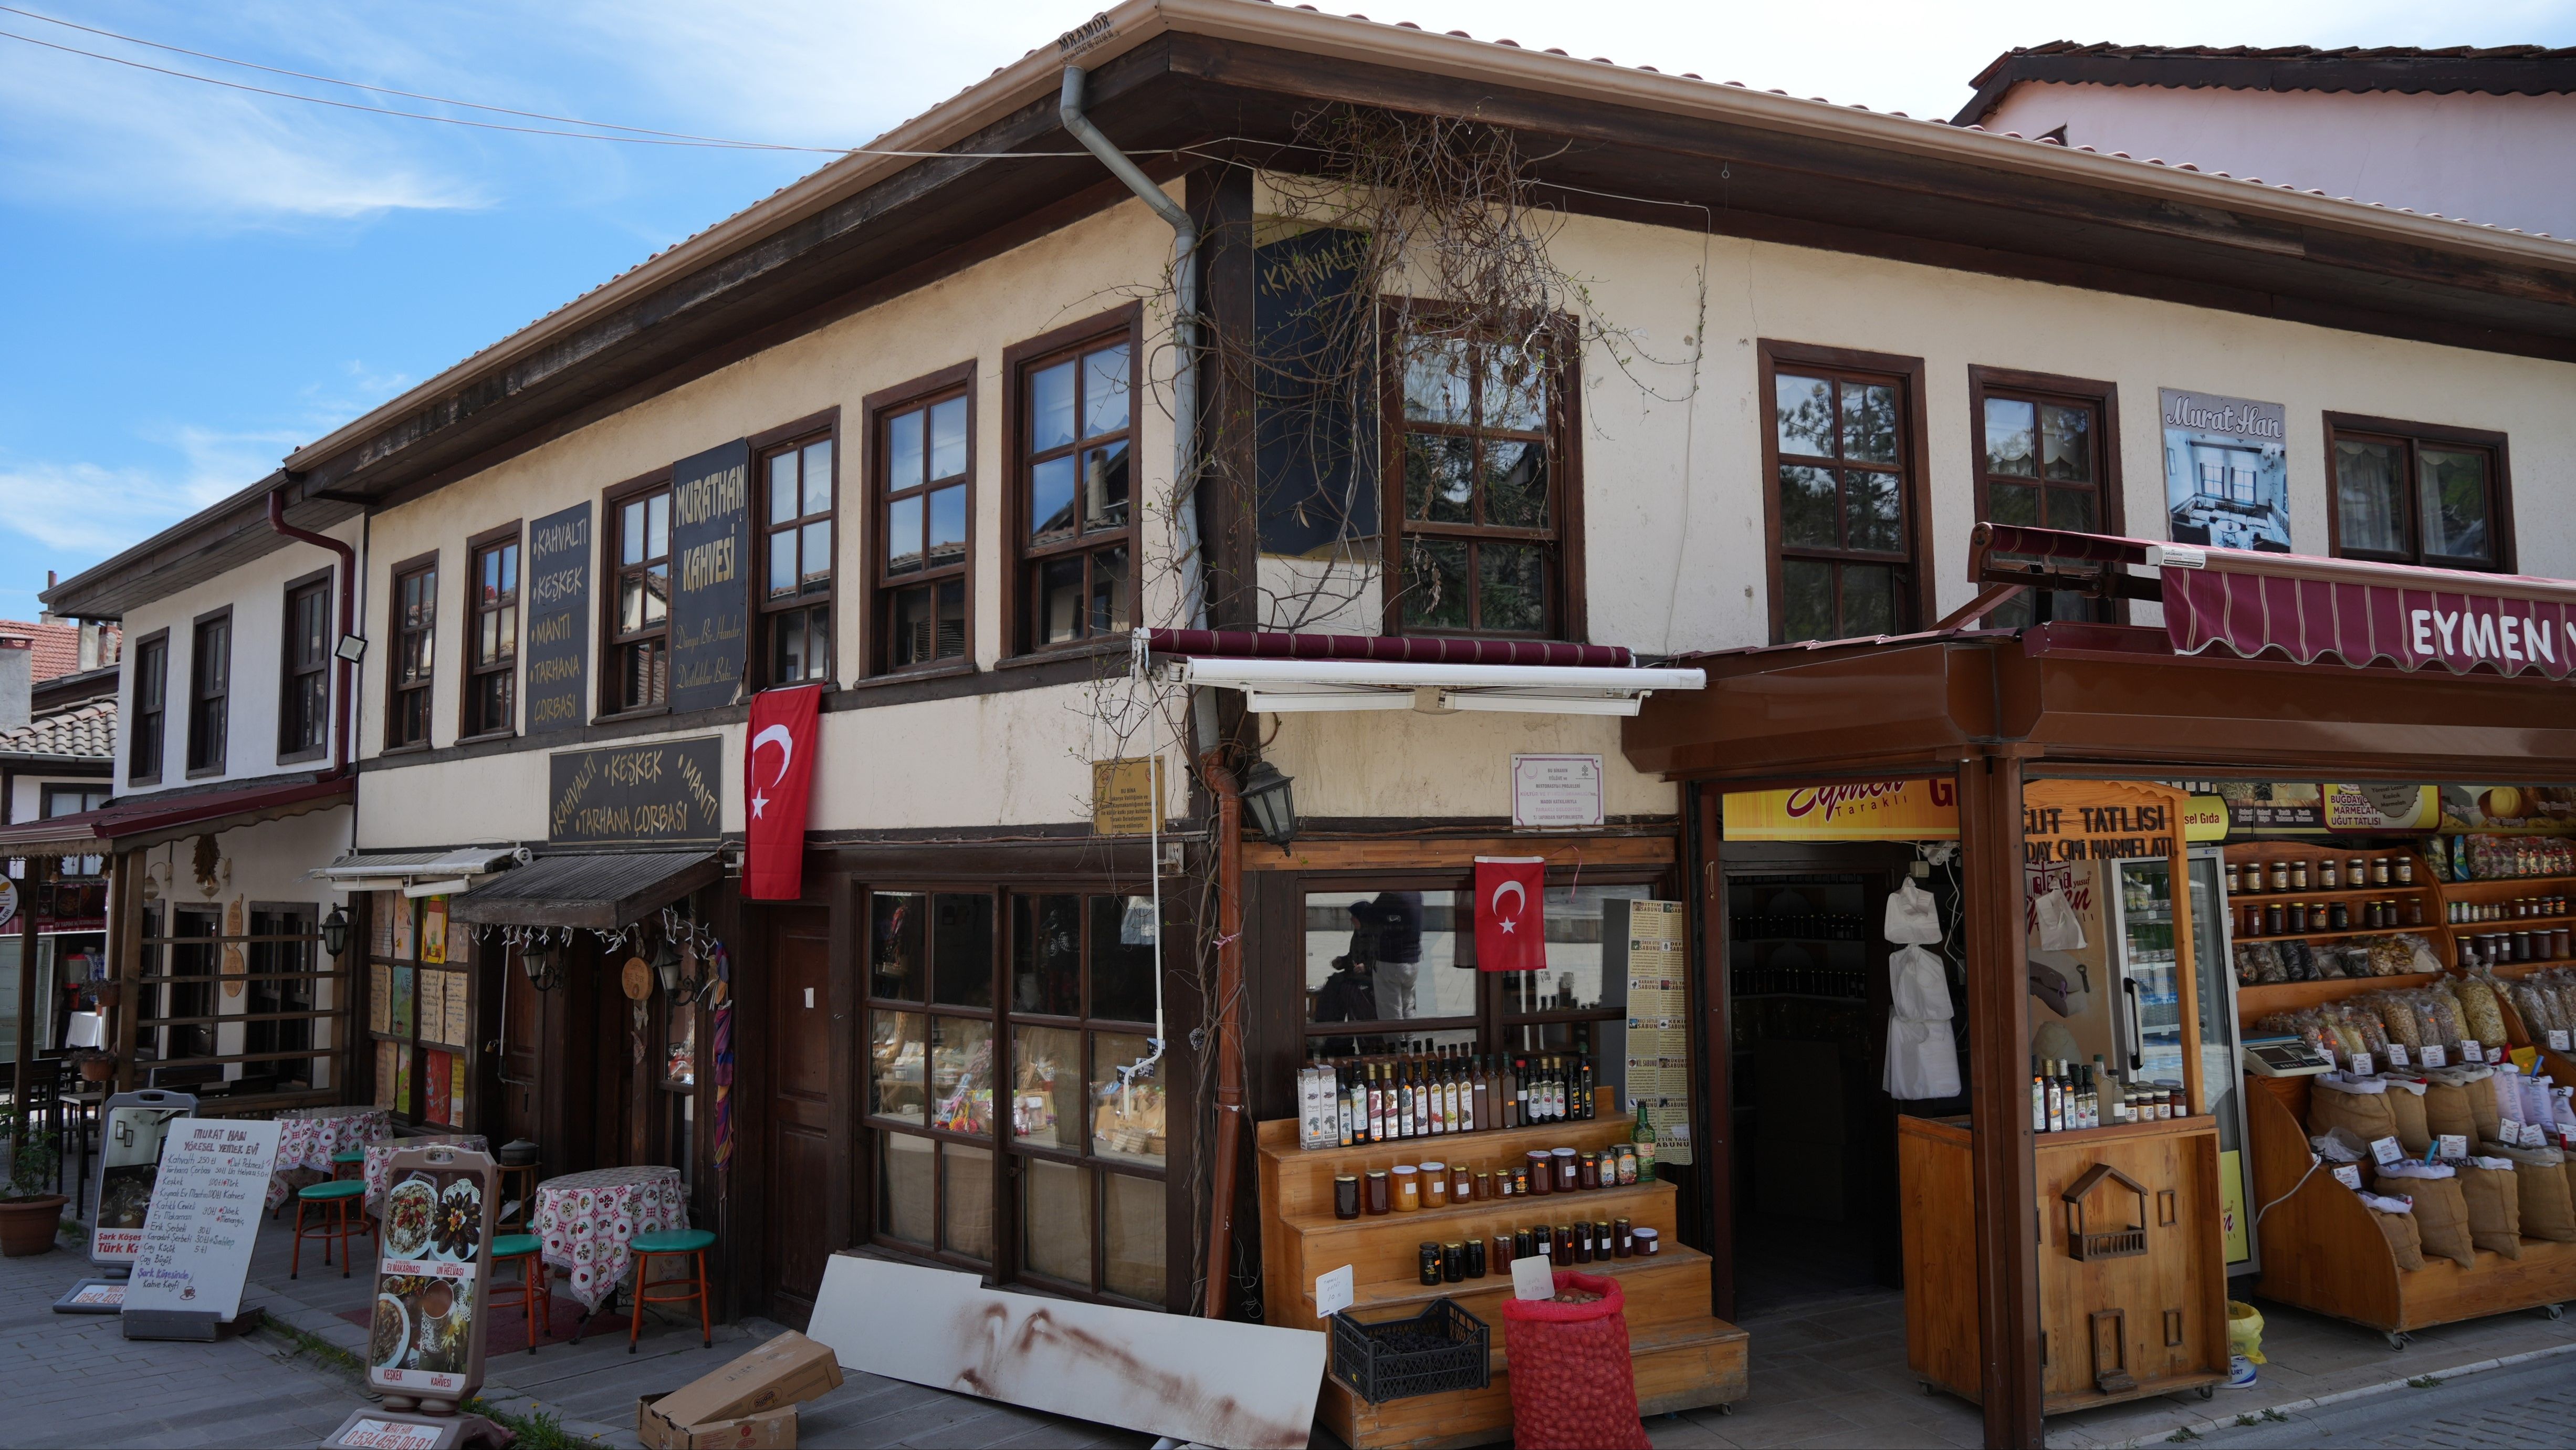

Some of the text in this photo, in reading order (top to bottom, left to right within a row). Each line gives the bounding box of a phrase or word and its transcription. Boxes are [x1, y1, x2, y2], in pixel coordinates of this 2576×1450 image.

[1057, 14, 1111, 53] MRAMOR
[2166, 396, 2282, 439] Murat Han
[676, 464, 745, 527] MURATHAN
[538, 518, 587, 561] KAHVALTI
[683, 524, 735, 594] KAHVESİ
[538, 566, 582, 604] KEŞKEK
[537, 613, 571, 646] MANTI
[675, 624, 699, 654] Dünya
[700, 618, 713, 644] Bir
[2411, 609, 2555, 664] EYMEN
[535, 654, 580, 684] TARHANA
[676, 661, 713, 690] Dostluklar
[535, 694, 576, 726] ÇORBASI
[554, 749, 718, 834] KAHVALTI KEŞKEK MANTI
[2331, 794, 2360, 804] BUĞDAY
[1835, 795, 1907, 817] Taraklı
[580, 800, 687, 837] TARHANA ÇORBASI
[2080, 805, 2165, 833] TATLISI
[2201, 813, 2219, 824] Gıda
[2331, 816, 2381, 826] UĞUT TATLISI
[2092, 837, 2175, 859] MARMELATI
[2073, 877, 2090, 889] yusuf
[194, 1129, 247, 1141] MURAT HAN
[184, 1142, 260, 1155] YÖRESEL YEMEK EVİ
[165, 1165, 188, 1174] Tarhana
[154, 1211, 161, 1219] Ev
[222, 1206, 239, 1215] Dibek
[151, 1222, 163, 1232] Erik
[165, 1223, 187, 1233] Şerbeti
[171, 1235, 192, 1244] Şerbeti
[98, 1243, 122, 1253] Türk
[144, 1243, 155, 1254] Çay
[159, 1243, 175, 1253] Küçük
[140, 1254, 172, 1266] Çay Büyük
[138, 1268, 154, 1279] Şark
[386, 1263, 420, 1274] EV MAKARNASI
[436, 1266, 464, 1276] UN HELVASI
[163, 1281, 180, 1292] Keyfi
[76, 1293, 121, 1303] 0542 403
[384, 1369, 403, 1382] KEŞKEK
[431, 1376, 452, 1388] KAHVESİ
[381, 1423, 415, 1434] MURAT HAN
[344, 1431, 433, 1450] 0 534 456 00 91
